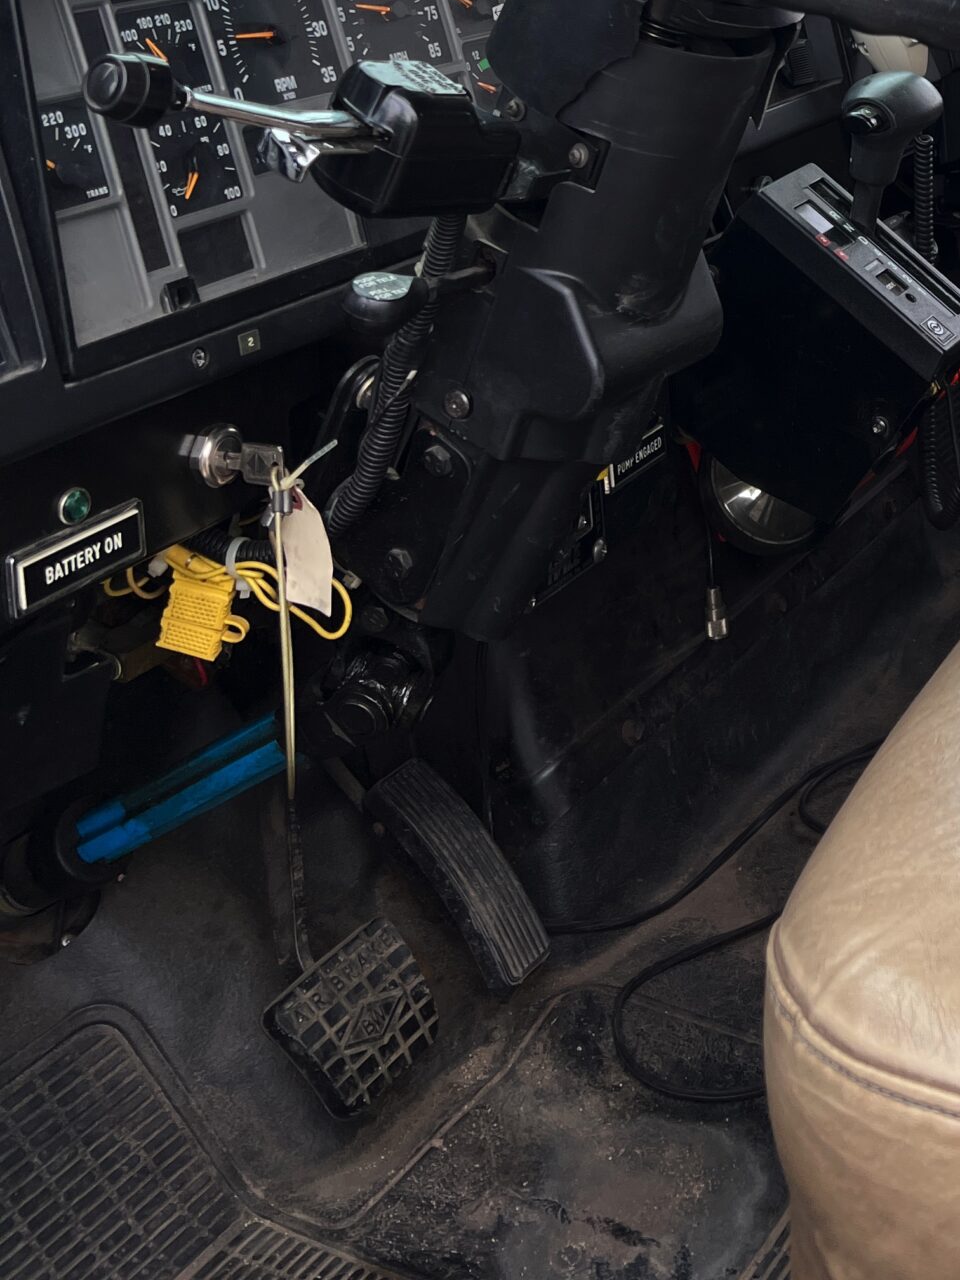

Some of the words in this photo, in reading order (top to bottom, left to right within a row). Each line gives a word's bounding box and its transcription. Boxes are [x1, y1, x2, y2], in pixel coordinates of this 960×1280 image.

[154, 13, 171, 27] 210
[424, 5, 438, 21] 75
[136, 17, 154, 30] 180
[174, 19, 193, 33] 230
[311, 20, 328, 37] 30
[121, 29, 138, 42] 100
[216, 39, 227, 56] 5
[428, 42, 442, 58] 85
[320, 66, 337, 84] 35
[274, 75, 297, 93] RPM
[41, 111, 64, 127] 220
[194, 115, 207, 129] 60
[64, 123, 87, 139] 300
[159, 124, 172, 137] 40
[217, 143, 230, 157] 80
[86, 186, 108, 199] TRANS
[224, 186, 241, 199] 100
[170, 205, 178, 217] 0
[247, 336, 255, 347] 2
[635, 436, 662, 463] ENGAGED
[45, 542, 101, 585] BATTERY
[104, 532, 123, 554] ON
